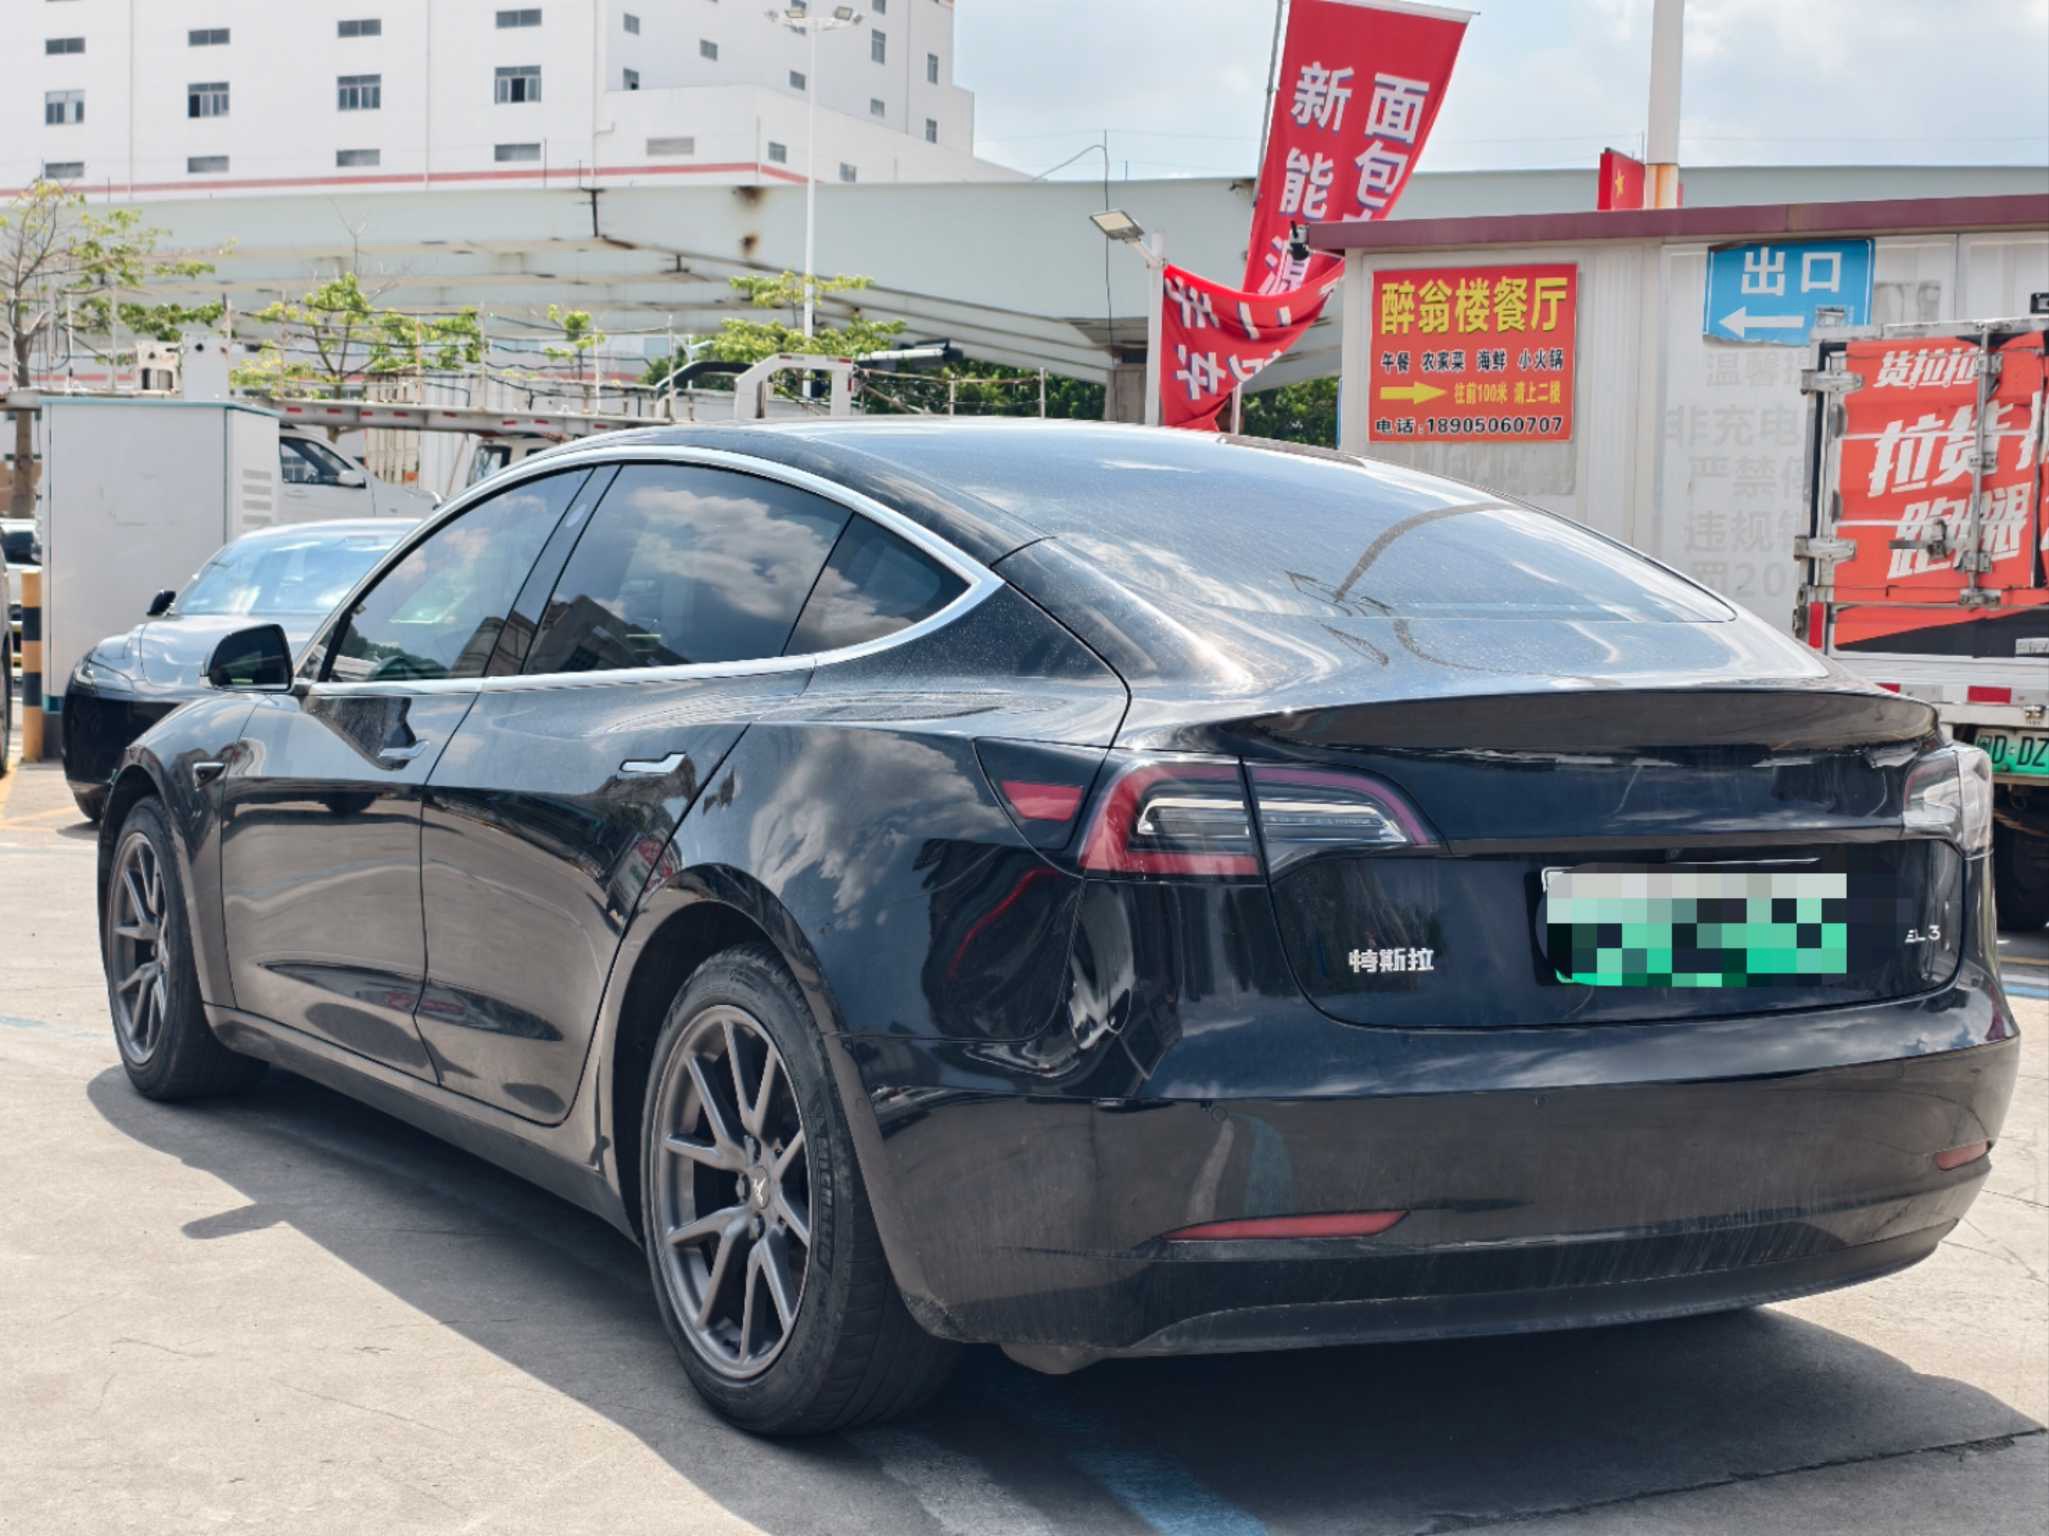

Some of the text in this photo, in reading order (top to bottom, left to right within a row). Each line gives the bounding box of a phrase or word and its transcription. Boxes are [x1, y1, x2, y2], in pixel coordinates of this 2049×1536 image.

[1343, 72, 1430, 221] 面包
[1741, 247, 1842, 296] 出口
[1381, 276, 1568, 334] 醉翁楼餐厅
[1422, 350, 1465, 372] 农家菜
[1477, 349, 1506, 371] 海鲜
[1519, 348, 1564, 370] 小火锅
[1873, 347, 1986, 390] 货拉拉
[1928, 924, 1941, 941] 3
[1348, 947, 1435, 973] 特斯拉
